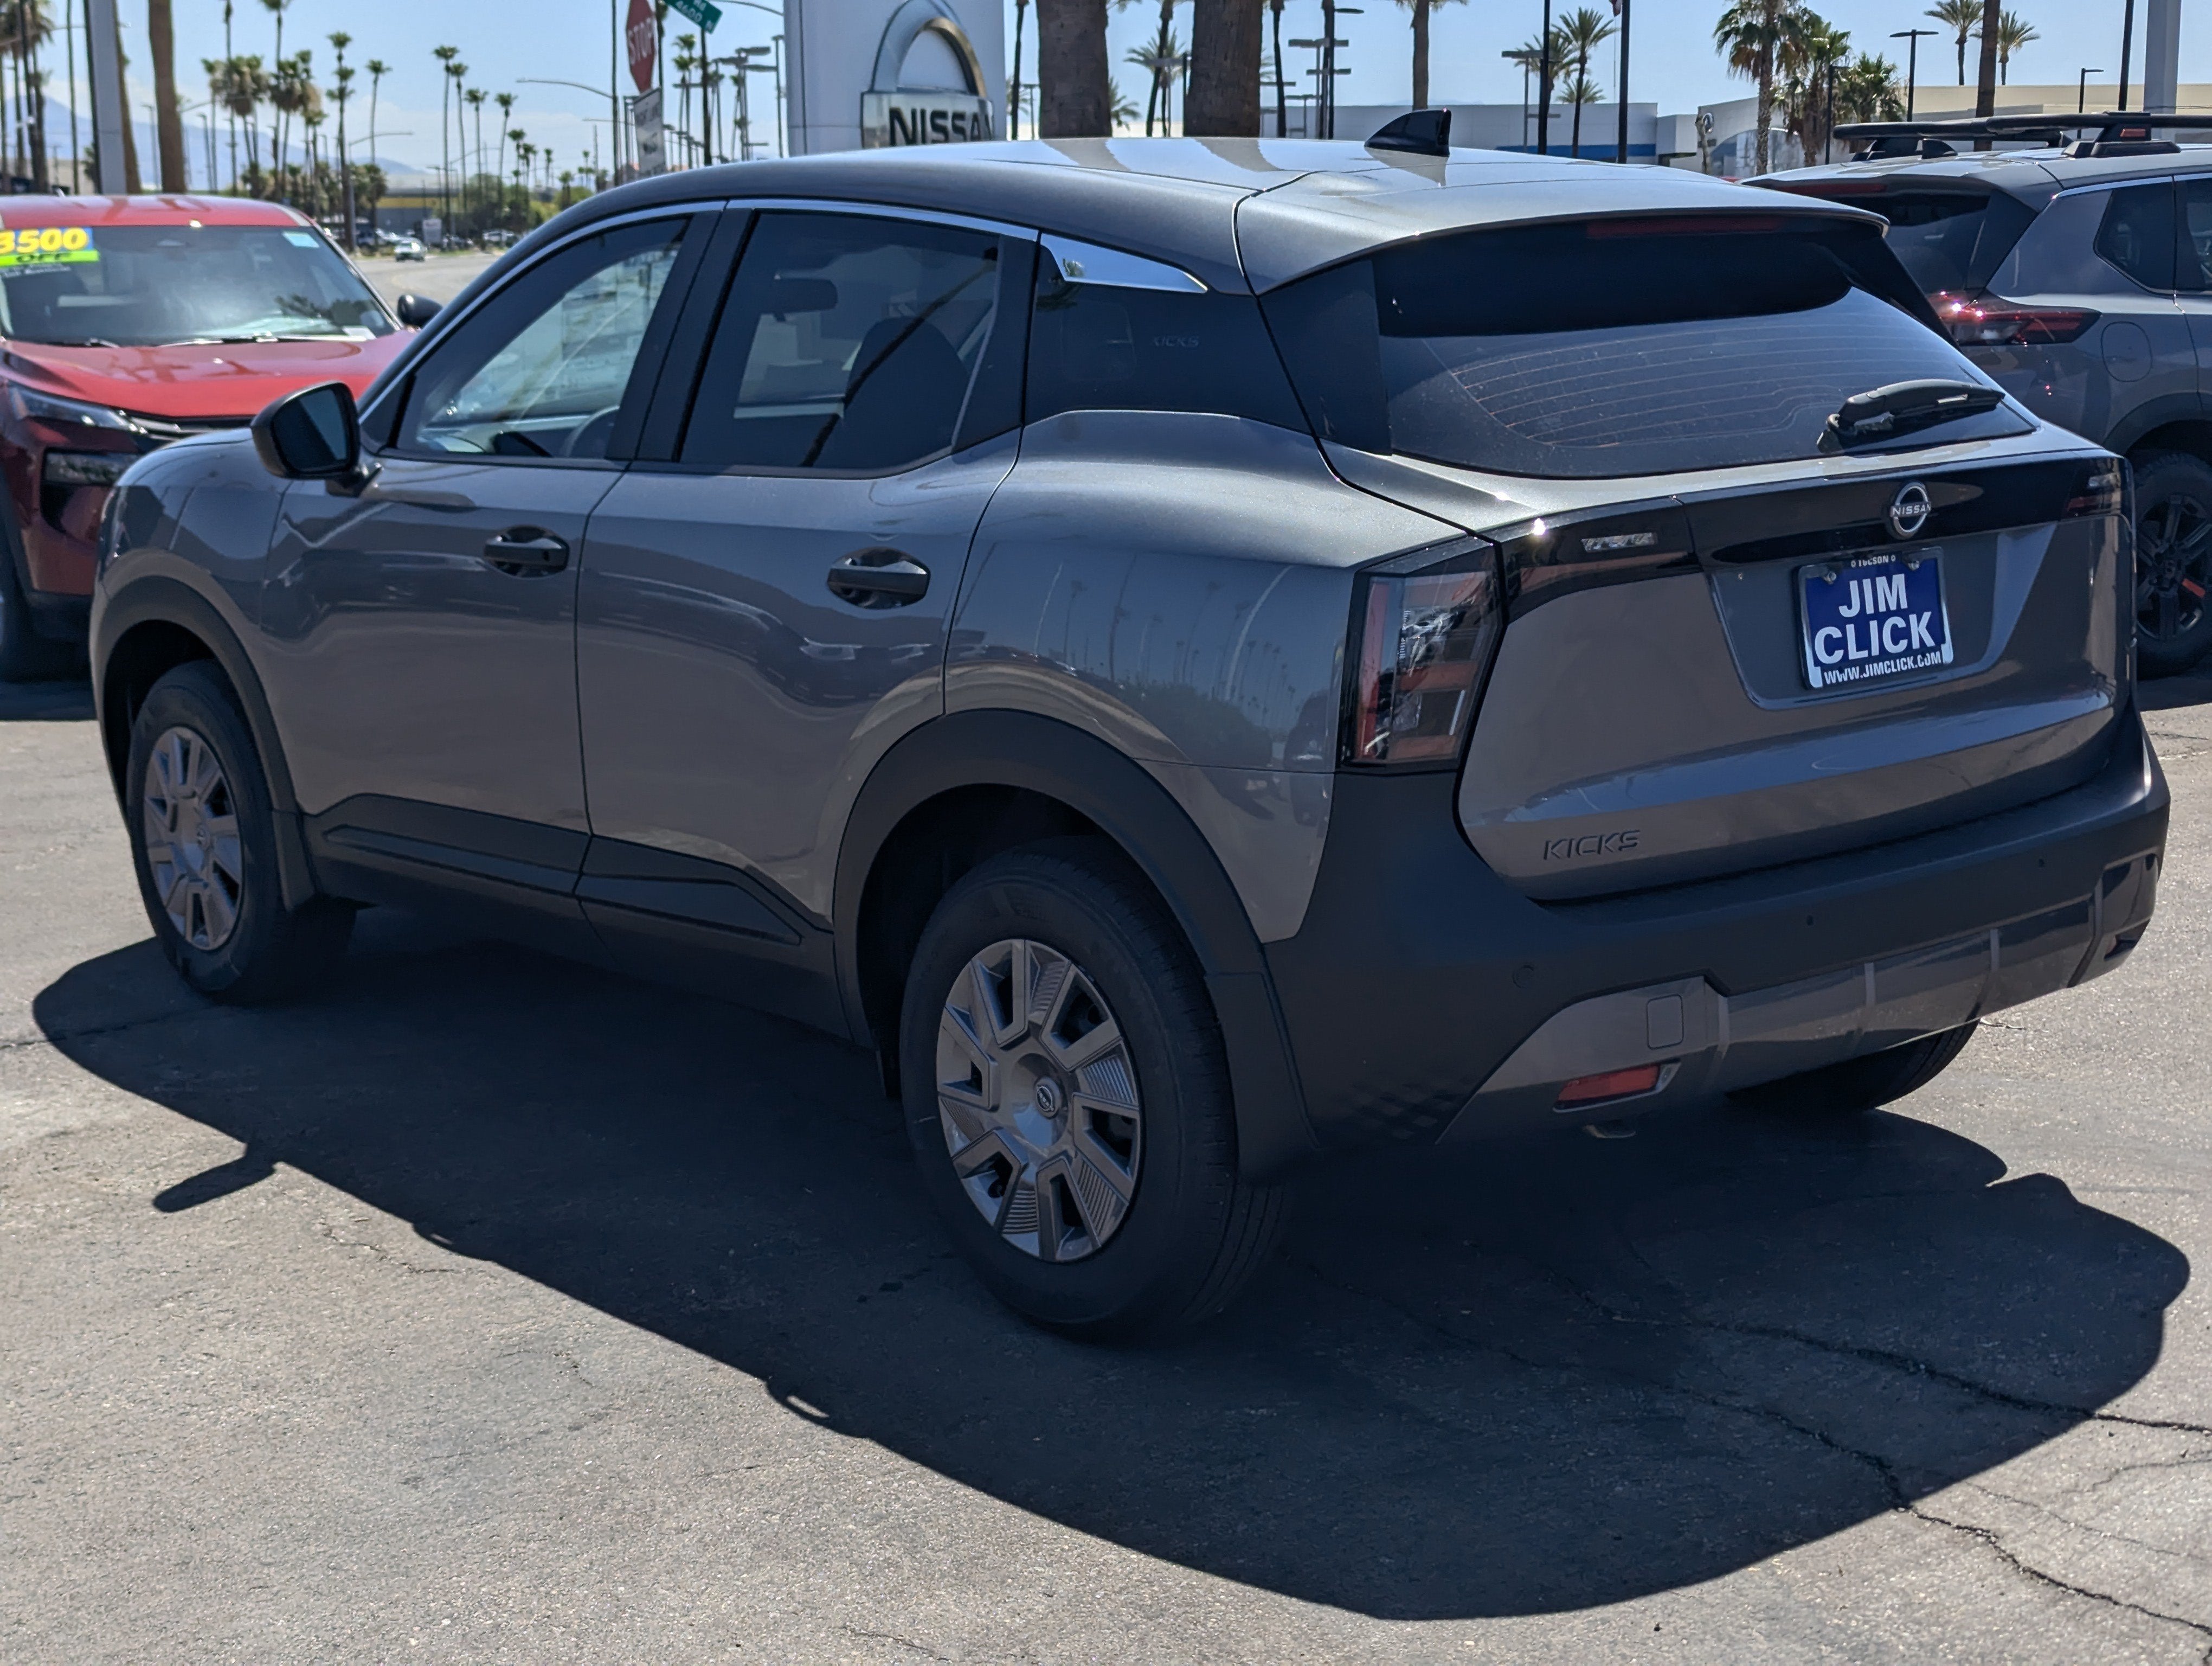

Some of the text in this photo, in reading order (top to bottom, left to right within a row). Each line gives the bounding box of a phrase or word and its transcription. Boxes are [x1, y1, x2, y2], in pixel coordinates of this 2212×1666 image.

[628, 17, 652, 65] STOP
[1892, 503, 1931, 516] NISSAN
[1858, 555, 1889, 567] TUCSON
[1838, 573, 1908, 618] JIM
[1815, 611, 1935, 664] CLICK
[1824, 651, 1941, 685] WWW.JIMCLICK.COM
[1544, 830, 1641, 860] KICKS
